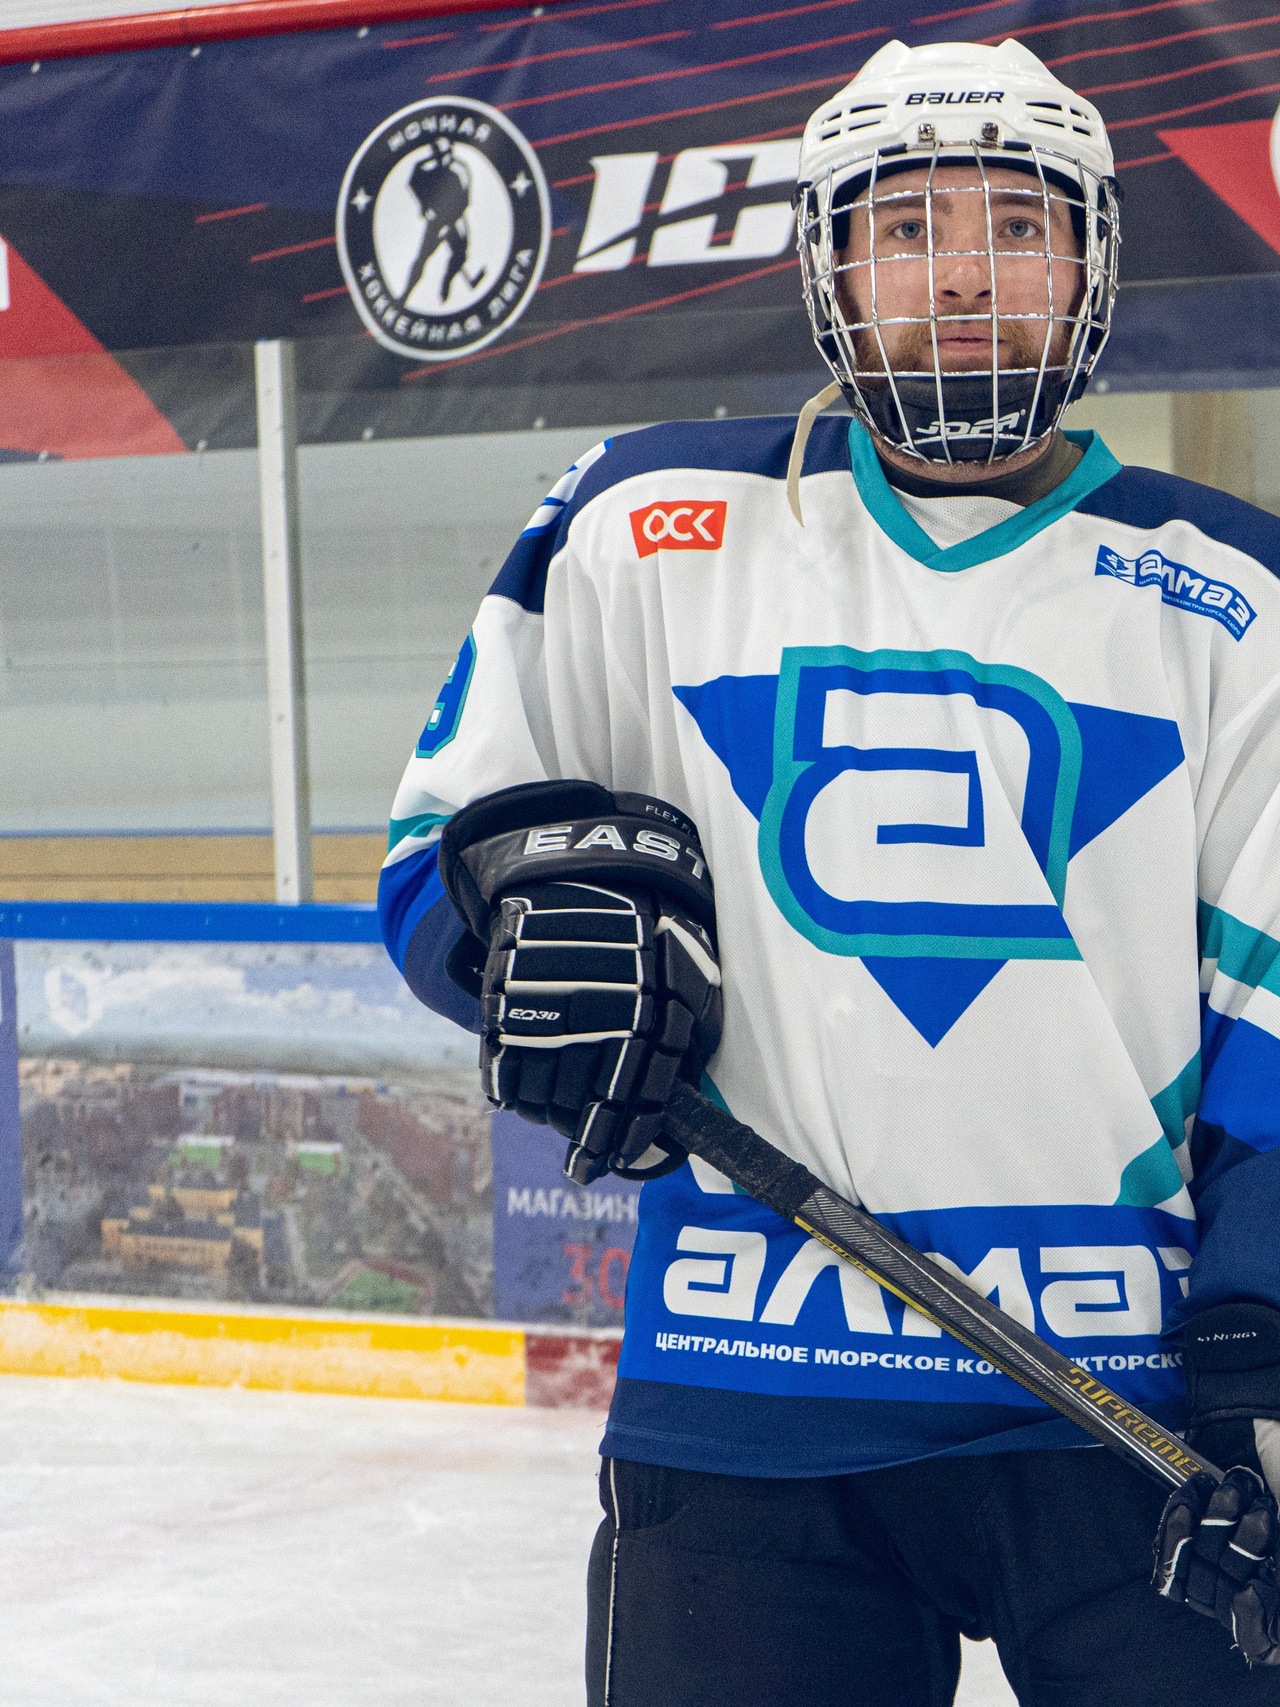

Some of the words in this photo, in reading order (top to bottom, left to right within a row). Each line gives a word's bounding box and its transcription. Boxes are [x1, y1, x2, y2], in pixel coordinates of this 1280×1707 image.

[905, 91, 1005, 106] BAUER
[358, 261, 483, 342] ХОККЕЙНАЯ
[488, 249, 534, 319] ЛИГА
[915, 411, 1020, 435] JOFA
[645, 804, 679, 824] FLEX
[663, 1226, 1194, 1338] алма
[655, 1332, 809, 1363] ЦЕНТРАЛЬНОЕ
[815, 1348, 950, 1372] МОРСКОЕ
